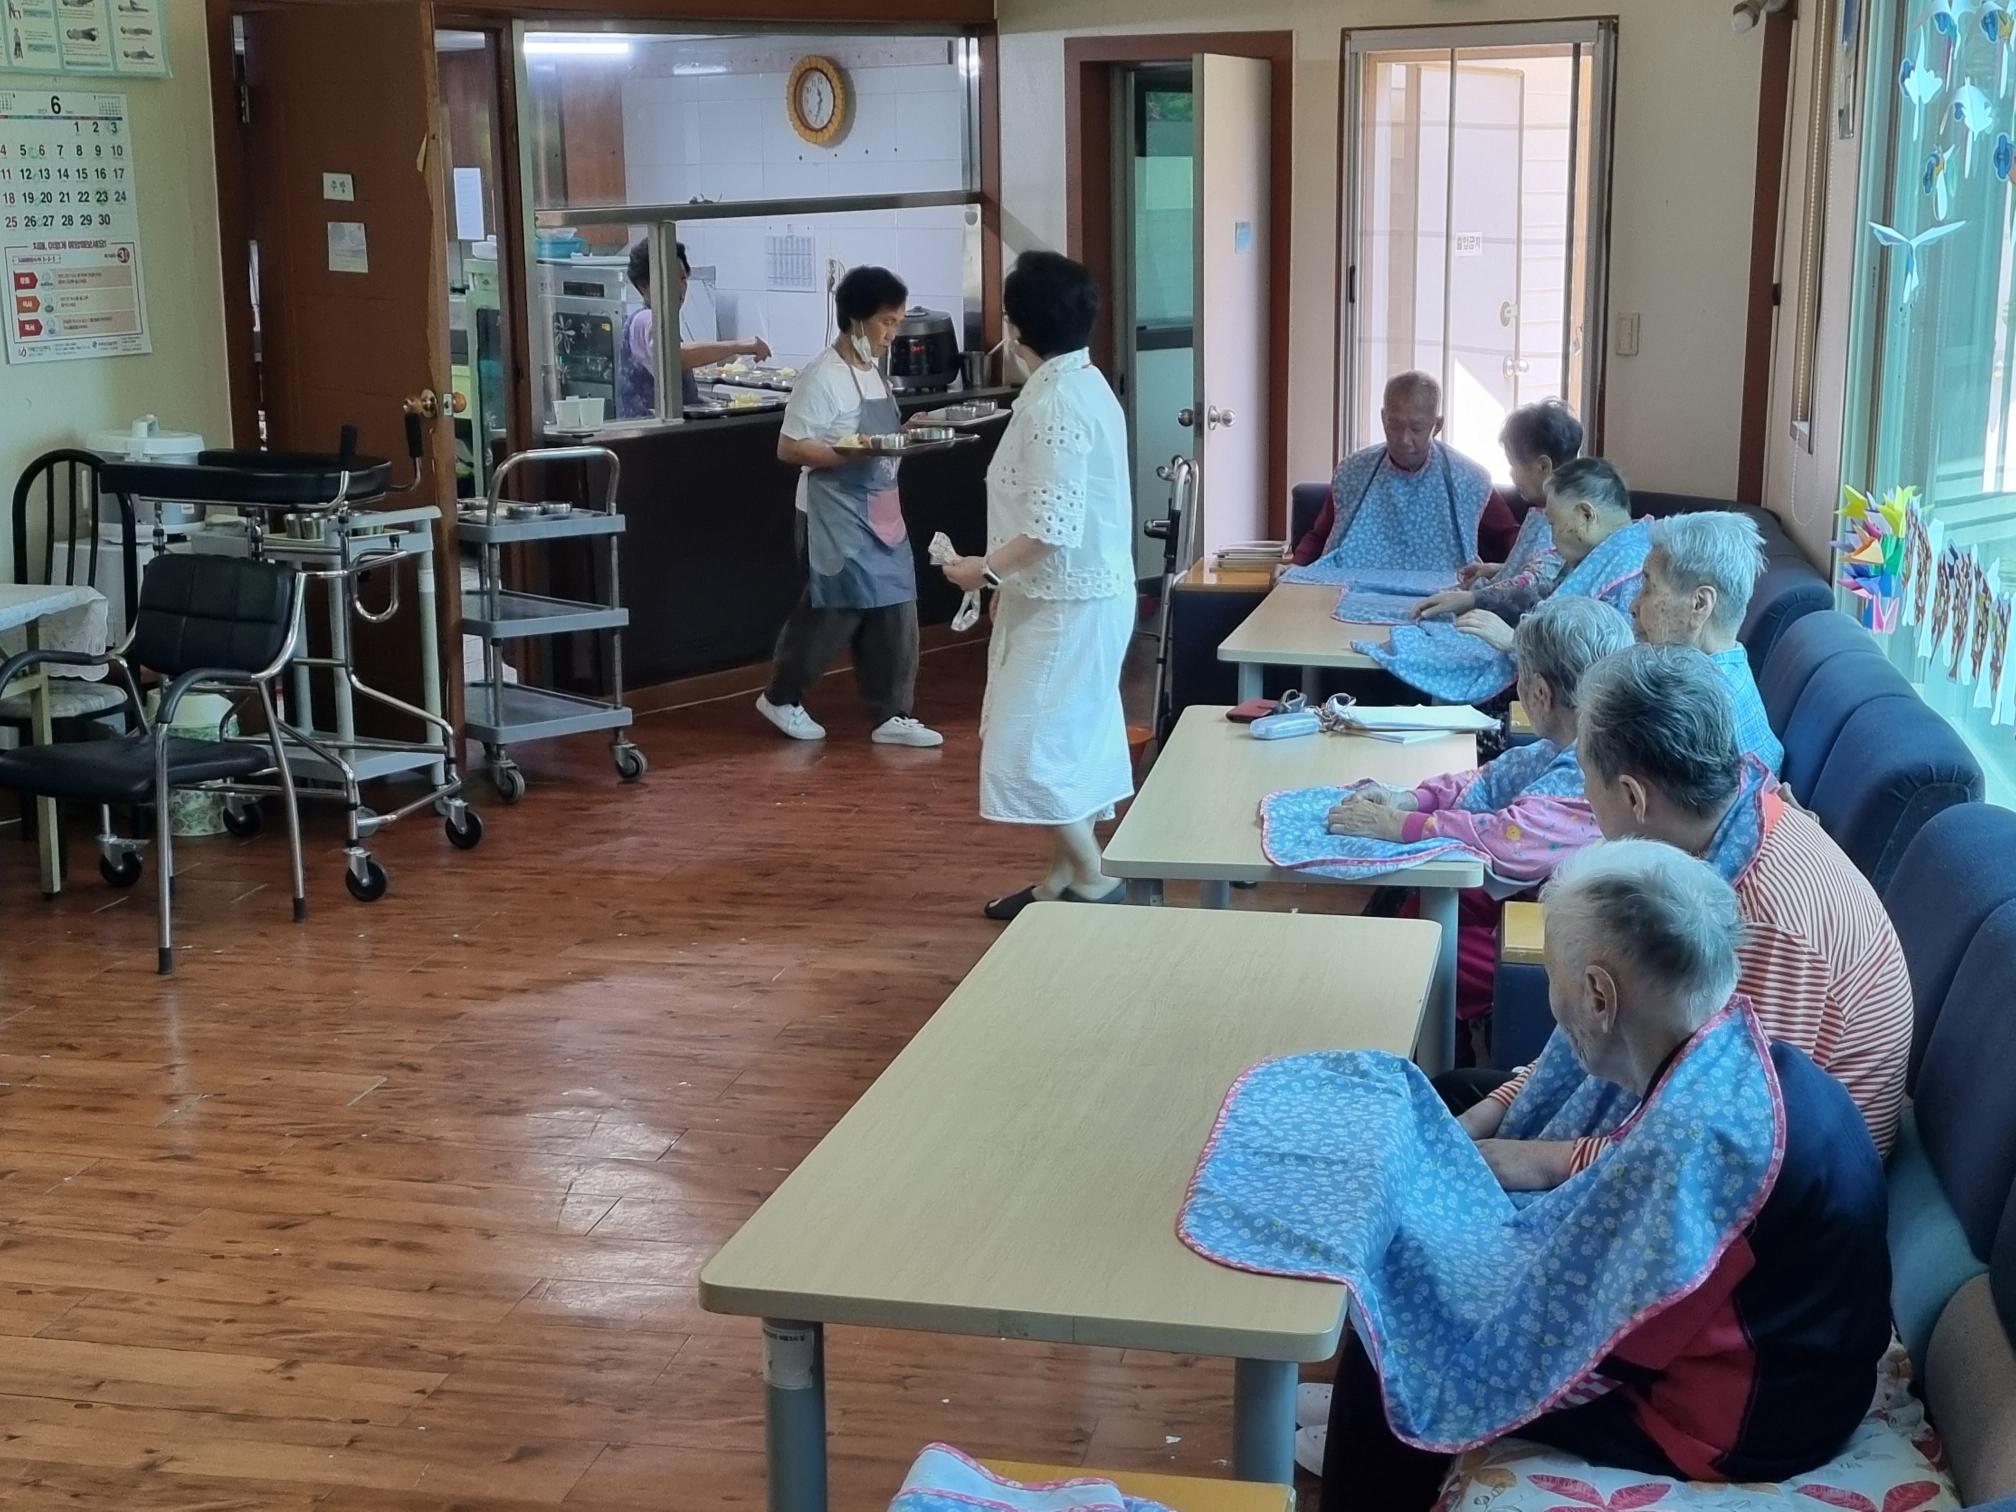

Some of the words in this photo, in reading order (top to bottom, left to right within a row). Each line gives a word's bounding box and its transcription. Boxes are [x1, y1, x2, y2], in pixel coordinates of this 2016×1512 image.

[51, 95, 61, 114] 6
[74, 122, 79, 132] 1
[92, 122, 99, 133] 2
[111, 122, 118, 133] 3
[0, 145, 6, 156] 4
[20, 144, 26, 156] 5
[39, 144, 45, 156] 6
[57, 145, 63, 156] 7
[76, 145, 82, 156] 8
[95, 145, 101, 156] 9
[111, 145, 123, 156] 10
[1, 168, 12, 180] 11
[20, 168, 32, 180] 12
[39, 168, 50, 179] 13
[57, 168, 69, 179] 14
[76, 168, 88, 179] 15
[94, 168, 106, 179] 16
[114, 168, 124, 179] 17
[3, 192, 16, 204] 18
[22, 192, 34, 204] 19
[40, 192, 52, 203] 20
[59, 192, 70, 203] 21
[78, 191, 90, 202] 22
[96, 191, 108, 202] 23
[114, 191, 126, 202] 24
[6, 216, 17, 228] 25
[24, 216, 36, 227] 26
[43, 215, 54, 226] 27
[62, 215, 73, 226] 28
[80, 215, 92, 226] 29
[99, 214, 110, 225] 30
[1456, 235, 1481, 250] 출입금지
